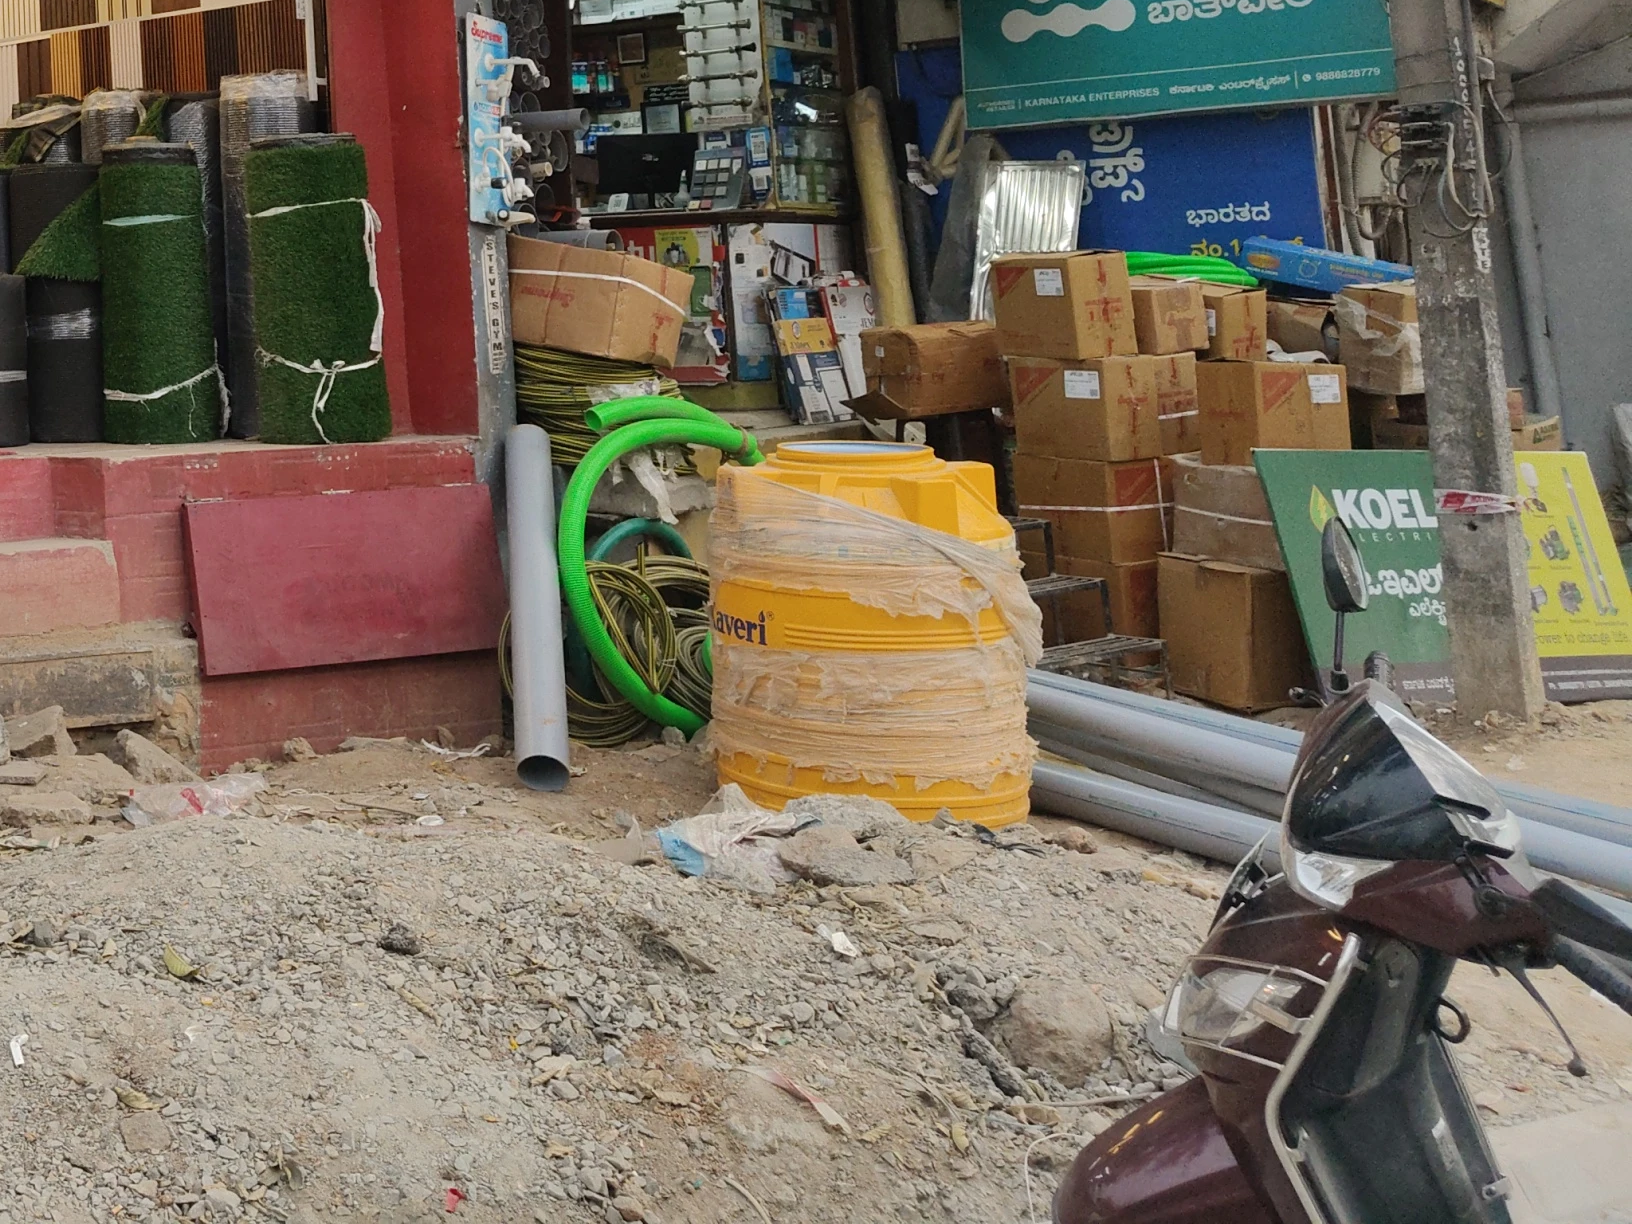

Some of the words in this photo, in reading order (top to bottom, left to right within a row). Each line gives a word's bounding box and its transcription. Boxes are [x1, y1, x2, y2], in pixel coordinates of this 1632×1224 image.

[1025, 93, 1086, 107] KARNATAKA
[1088, 87, 1159, 101] ENTERPRISES
[1331, 488, 1438, 530] KOEL
[713, 605, 767, 645] averi
